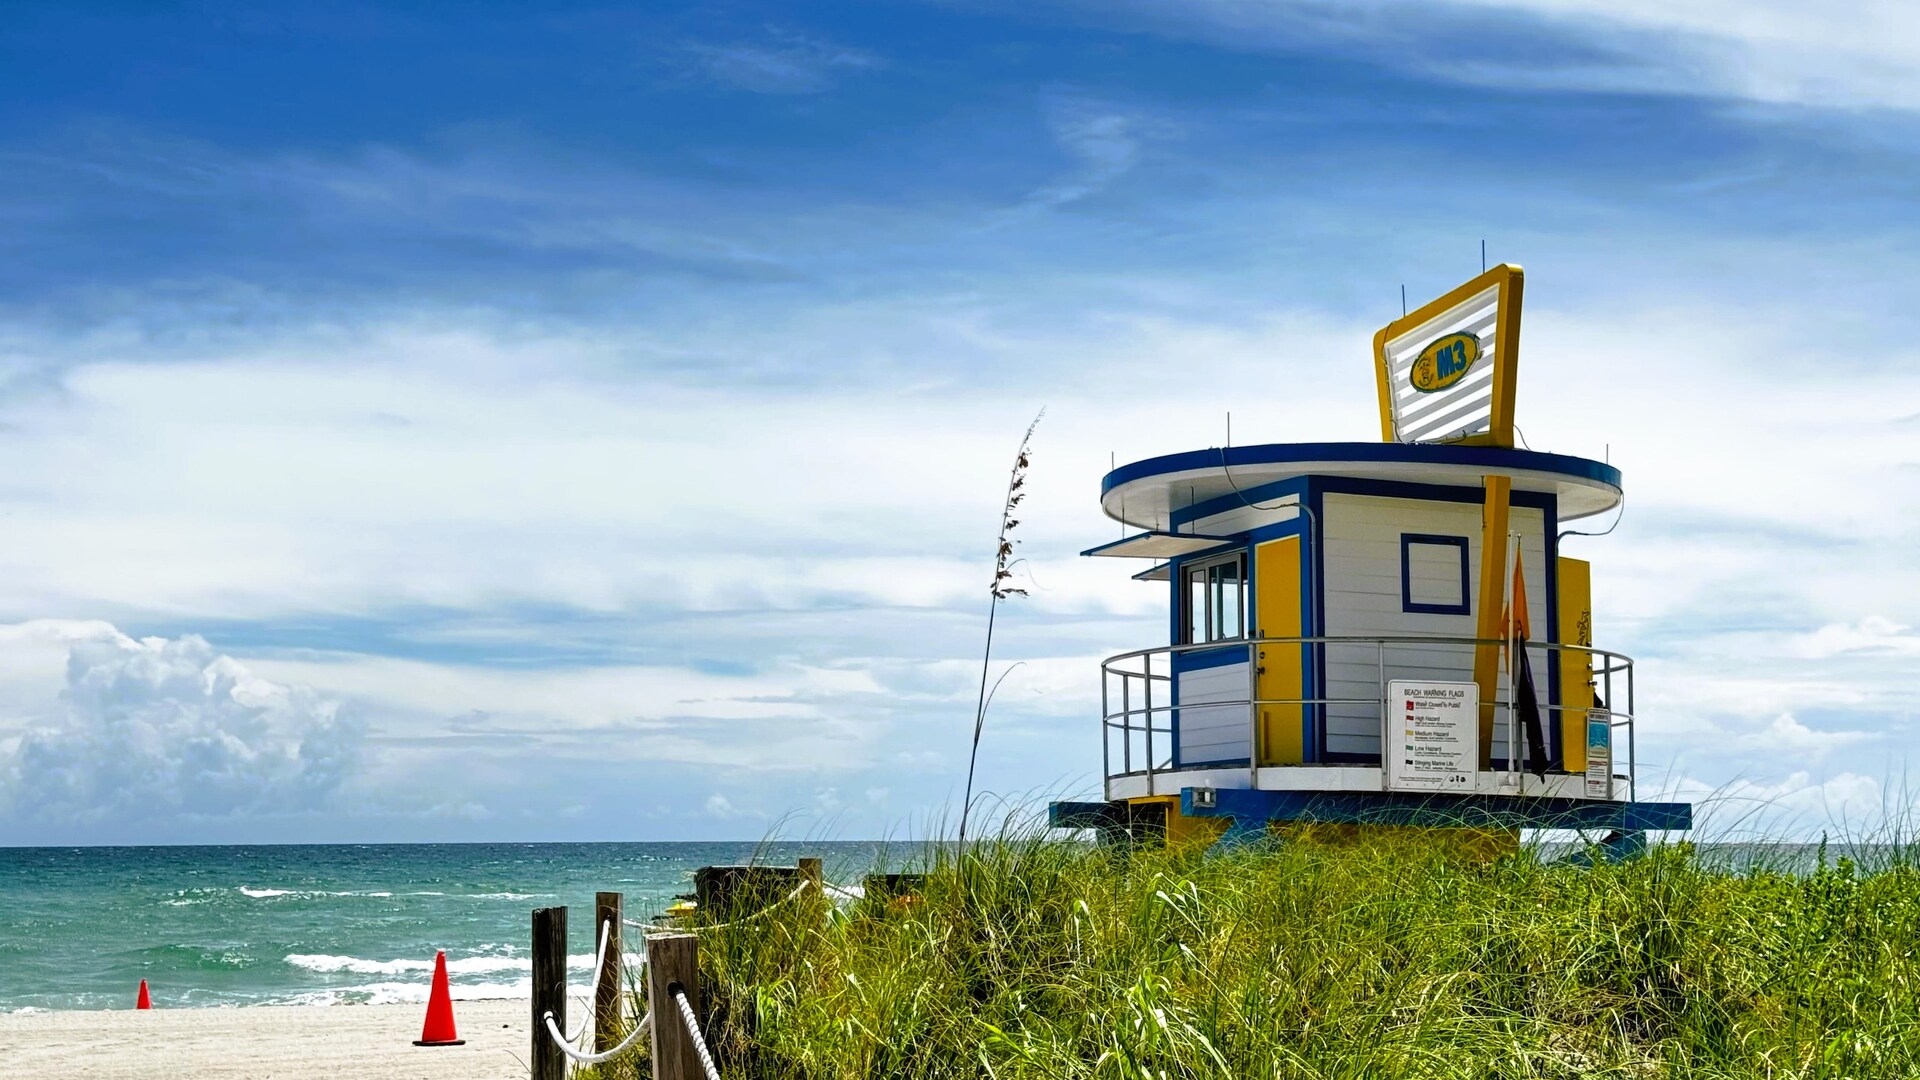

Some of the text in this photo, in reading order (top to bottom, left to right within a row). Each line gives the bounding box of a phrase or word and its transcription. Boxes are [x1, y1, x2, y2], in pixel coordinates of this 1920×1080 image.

[1436, 340, 1467, 380] M3
[1404, 688, 1421, 696] BEACH
[1423, 689, 1447, 697] WARNING
[1448, 690, 1465, 698] FLAGS
